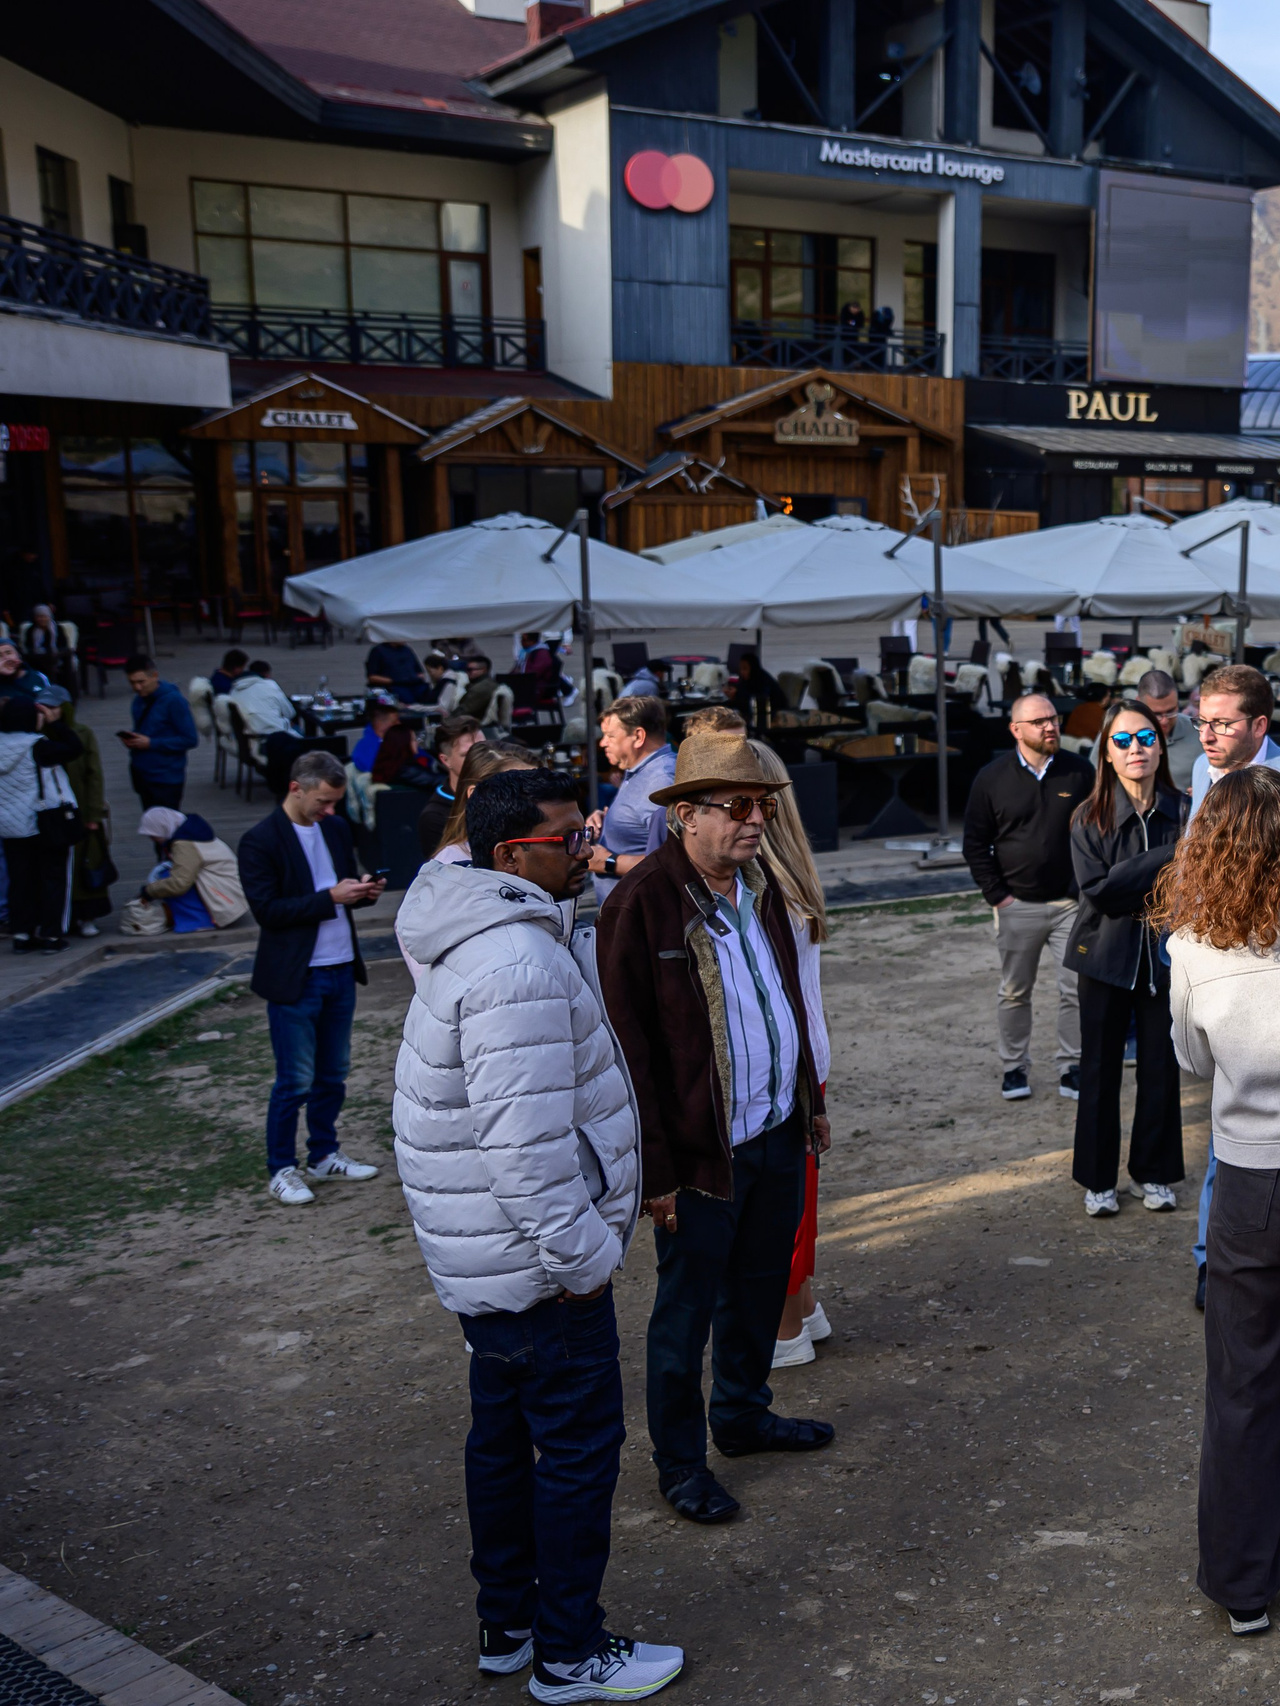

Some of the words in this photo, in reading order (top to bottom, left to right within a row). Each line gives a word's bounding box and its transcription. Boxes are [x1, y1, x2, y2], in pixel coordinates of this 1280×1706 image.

[820, 140, 933, 174] Mastercard
[937, 153, 1005, 185] lounge
[1066, 389, 1159, 422] PAUL
[272, 412, 347, 427] CHALET
[778, 421, 854, 437] CHALET
